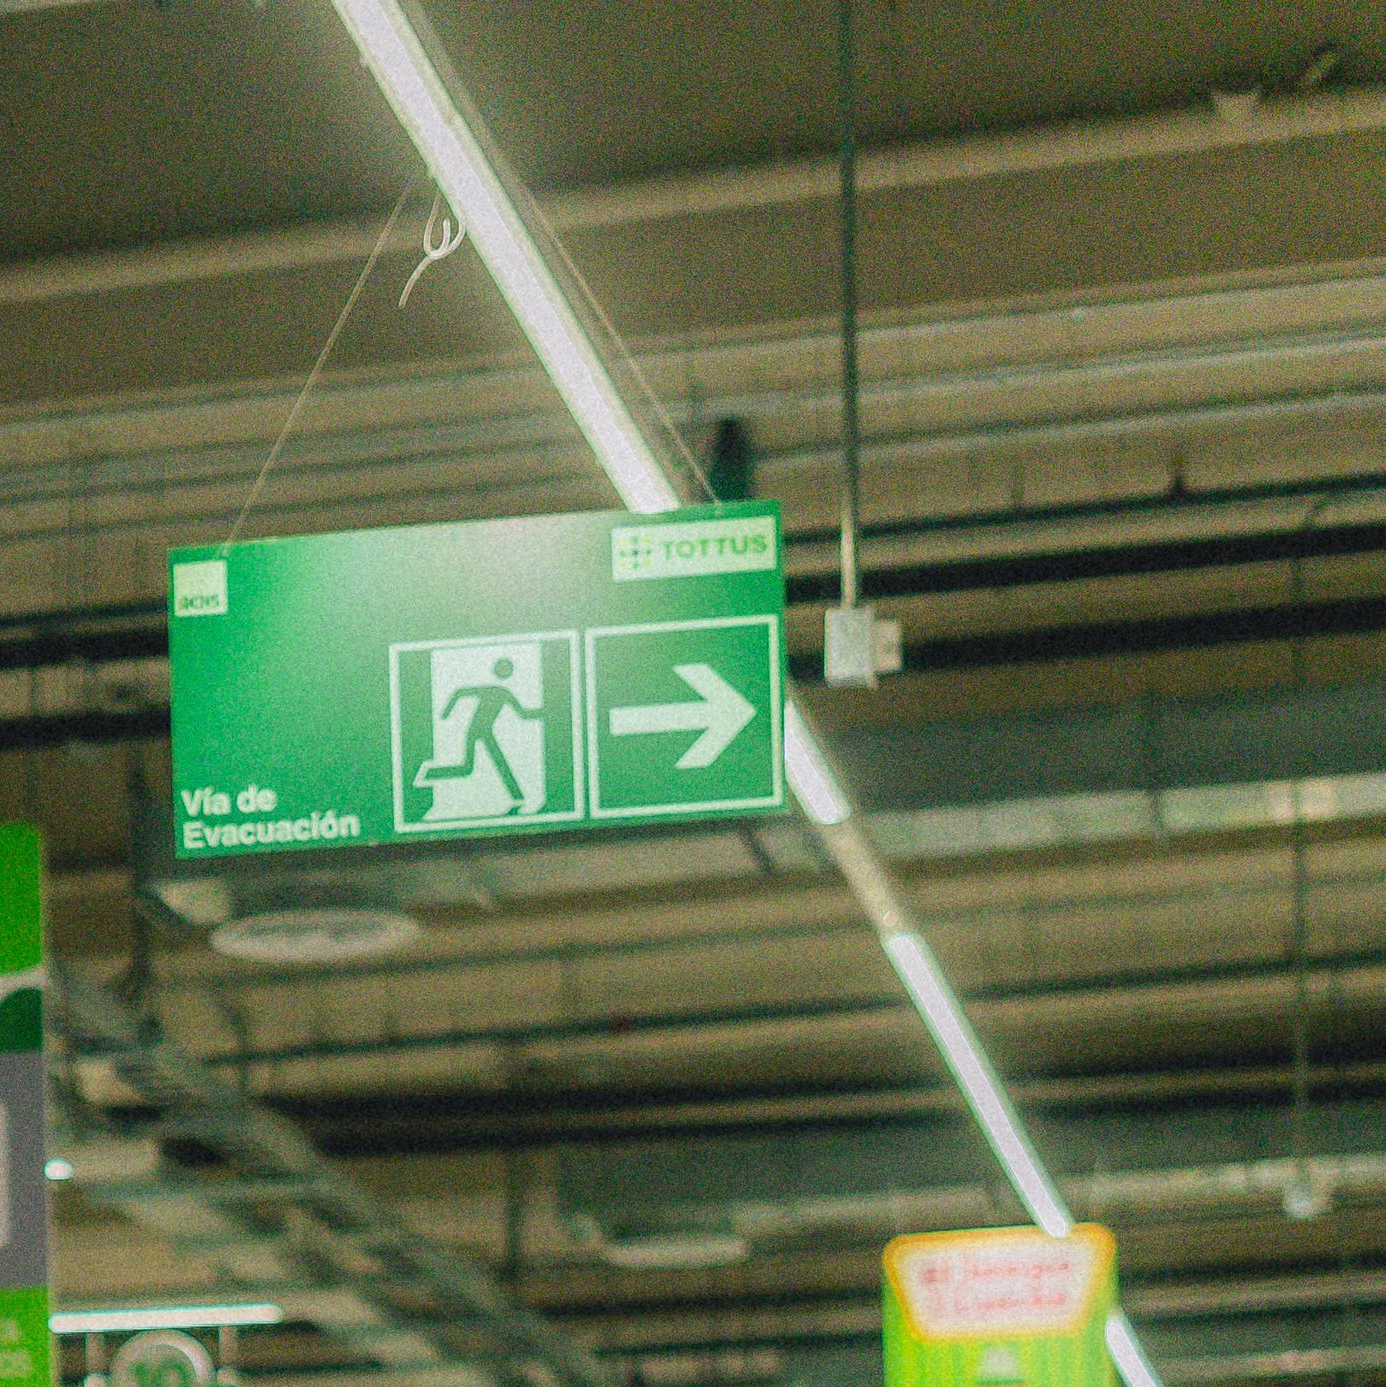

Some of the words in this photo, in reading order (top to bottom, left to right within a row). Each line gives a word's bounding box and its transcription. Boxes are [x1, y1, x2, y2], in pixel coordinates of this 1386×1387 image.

[664, 534, 768, 560] TOTTUS
[181, 785, 232, 817] Vía
[236, 783, 278, 814] de
[182, 809, 361, 849] Evacuación
